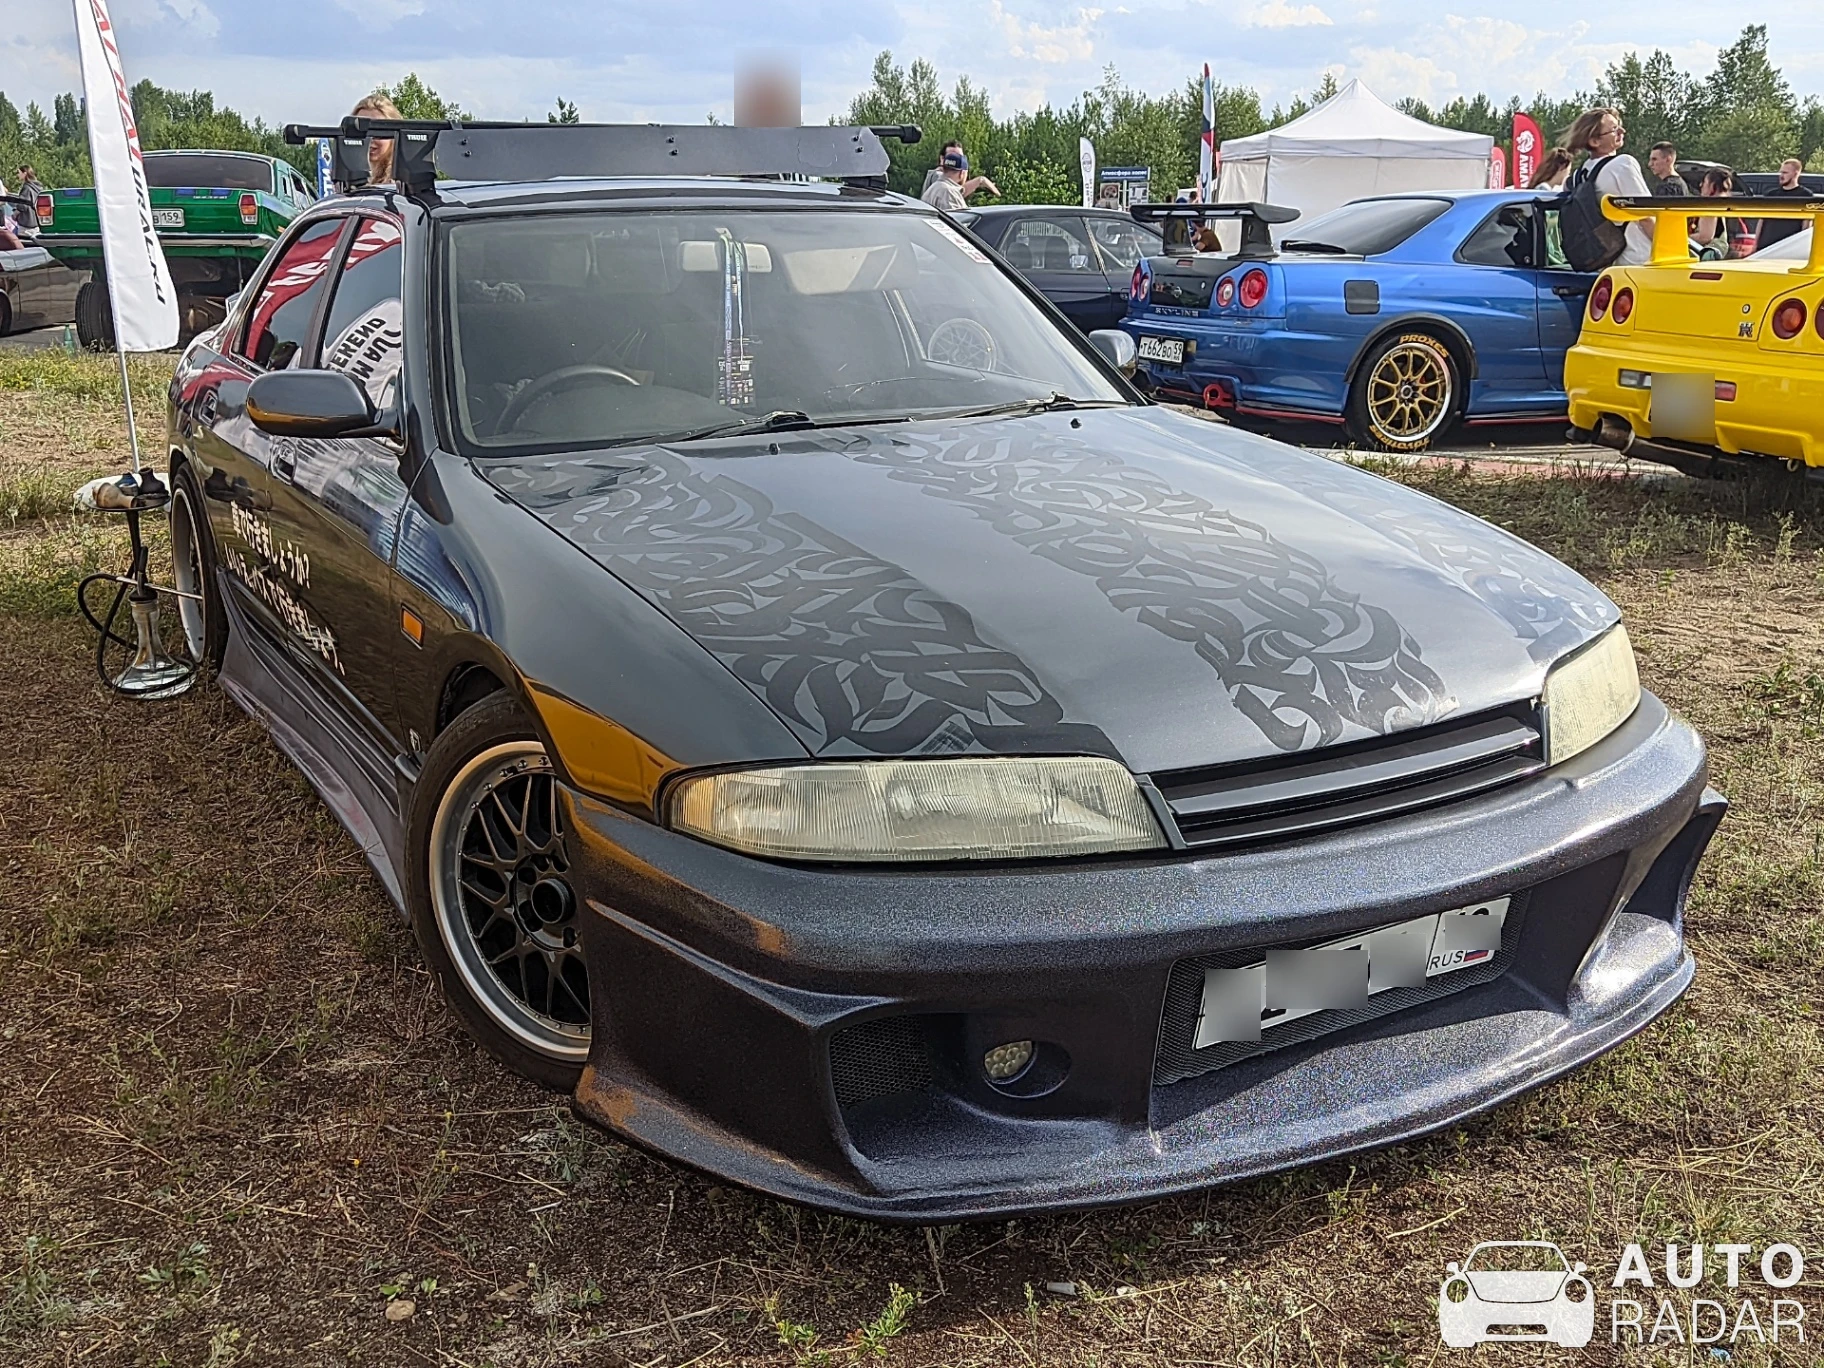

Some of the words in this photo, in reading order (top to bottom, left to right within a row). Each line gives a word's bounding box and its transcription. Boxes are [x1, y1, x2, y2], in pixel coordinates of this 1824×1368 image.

[162, 212, 178, 221] 159
[1174, 343, 1182, 356] 59
[1400, 334, 1450, 358] PROXES
[1429, 950, 1464, 971] RUS
